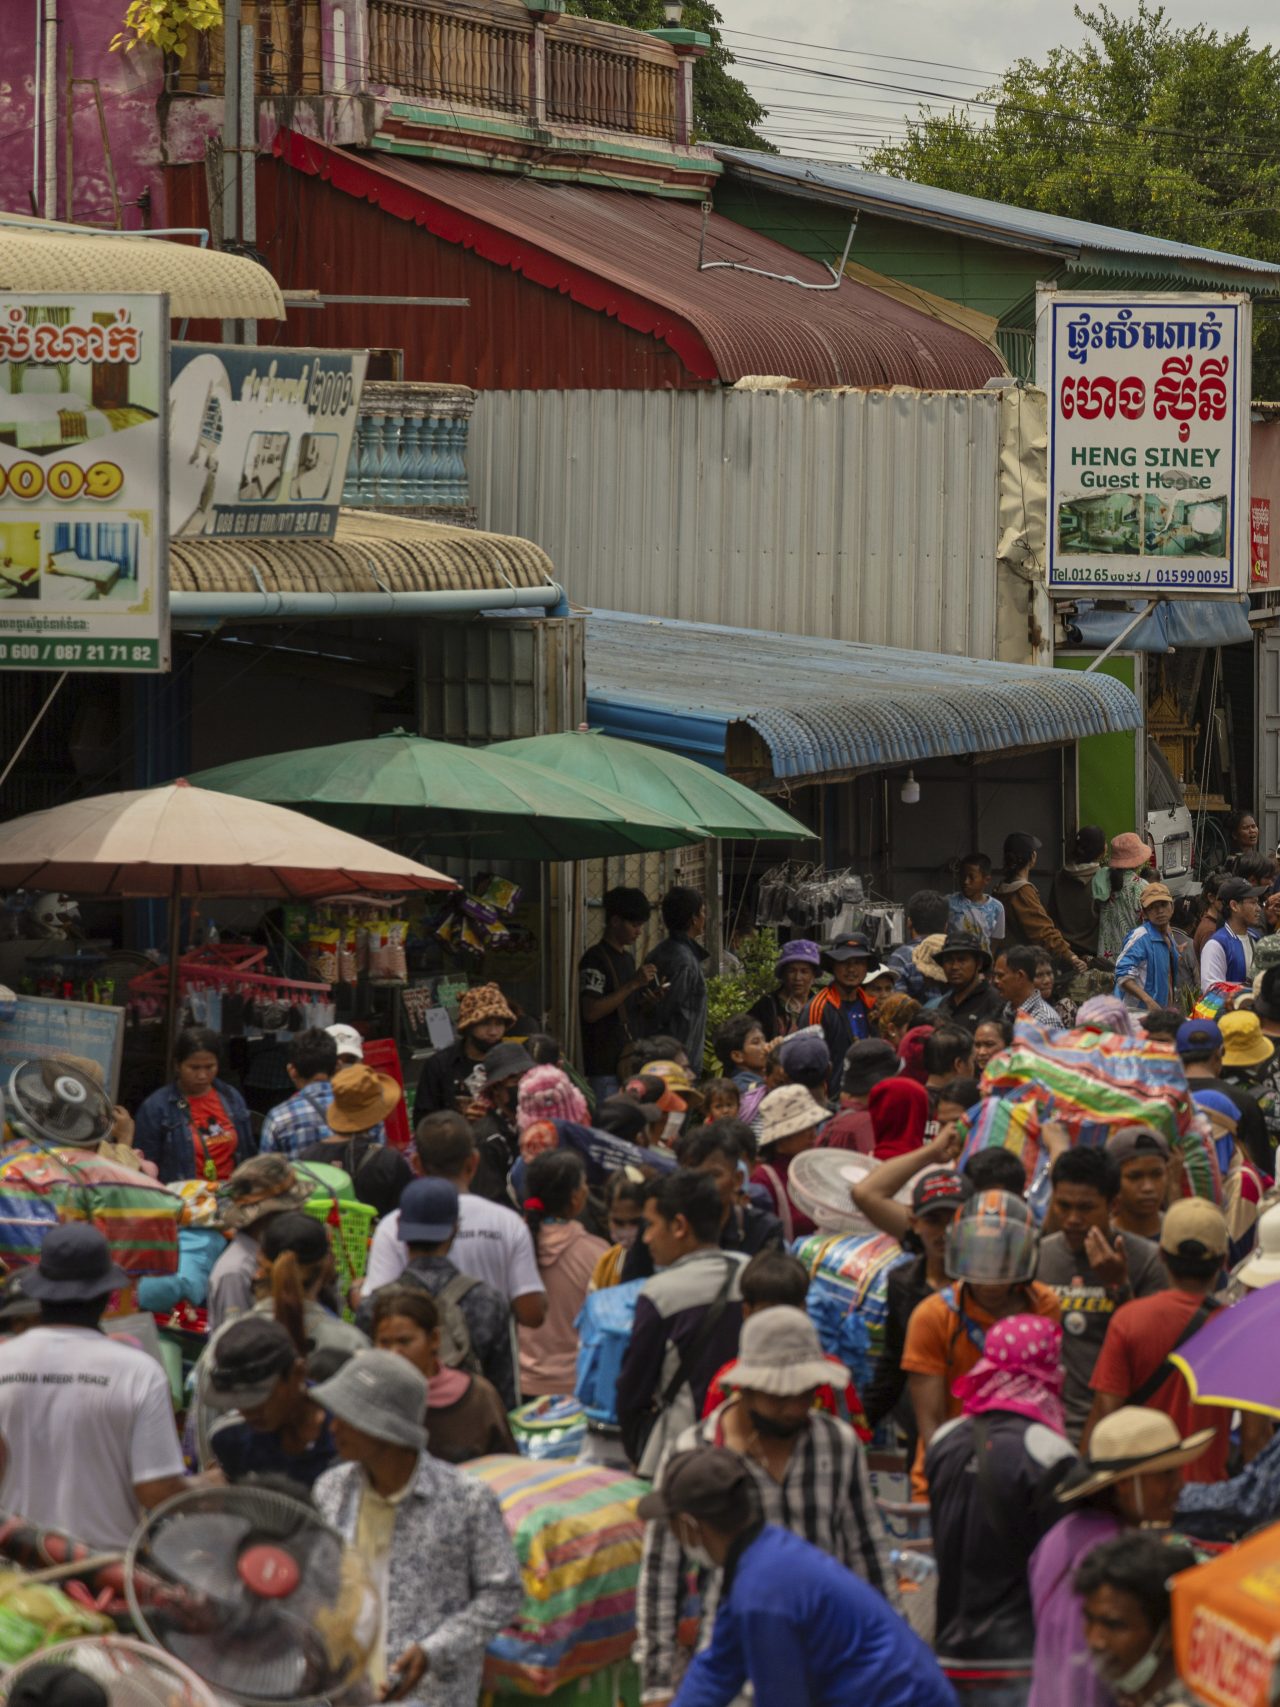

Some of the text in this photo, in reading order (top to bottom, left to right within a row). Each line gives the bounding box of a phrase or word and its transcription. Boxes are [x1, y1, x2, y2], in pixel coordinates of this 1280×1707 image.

[1066, 309, 1223, 365] ផ្ទះសំណាក់
[1061, 376, 1147, 420] ហេង
[1071, 447, 1222, 468] HENG SINEY
[1080, 470, 1140, 488] Guest
[11, 644, 39, 659] 600
[54, 645, 82, 660] 087
[86, 645, 105, 660] 21
[110, 646, 128, 660] 71
[132, 646, 151, 661] 82
